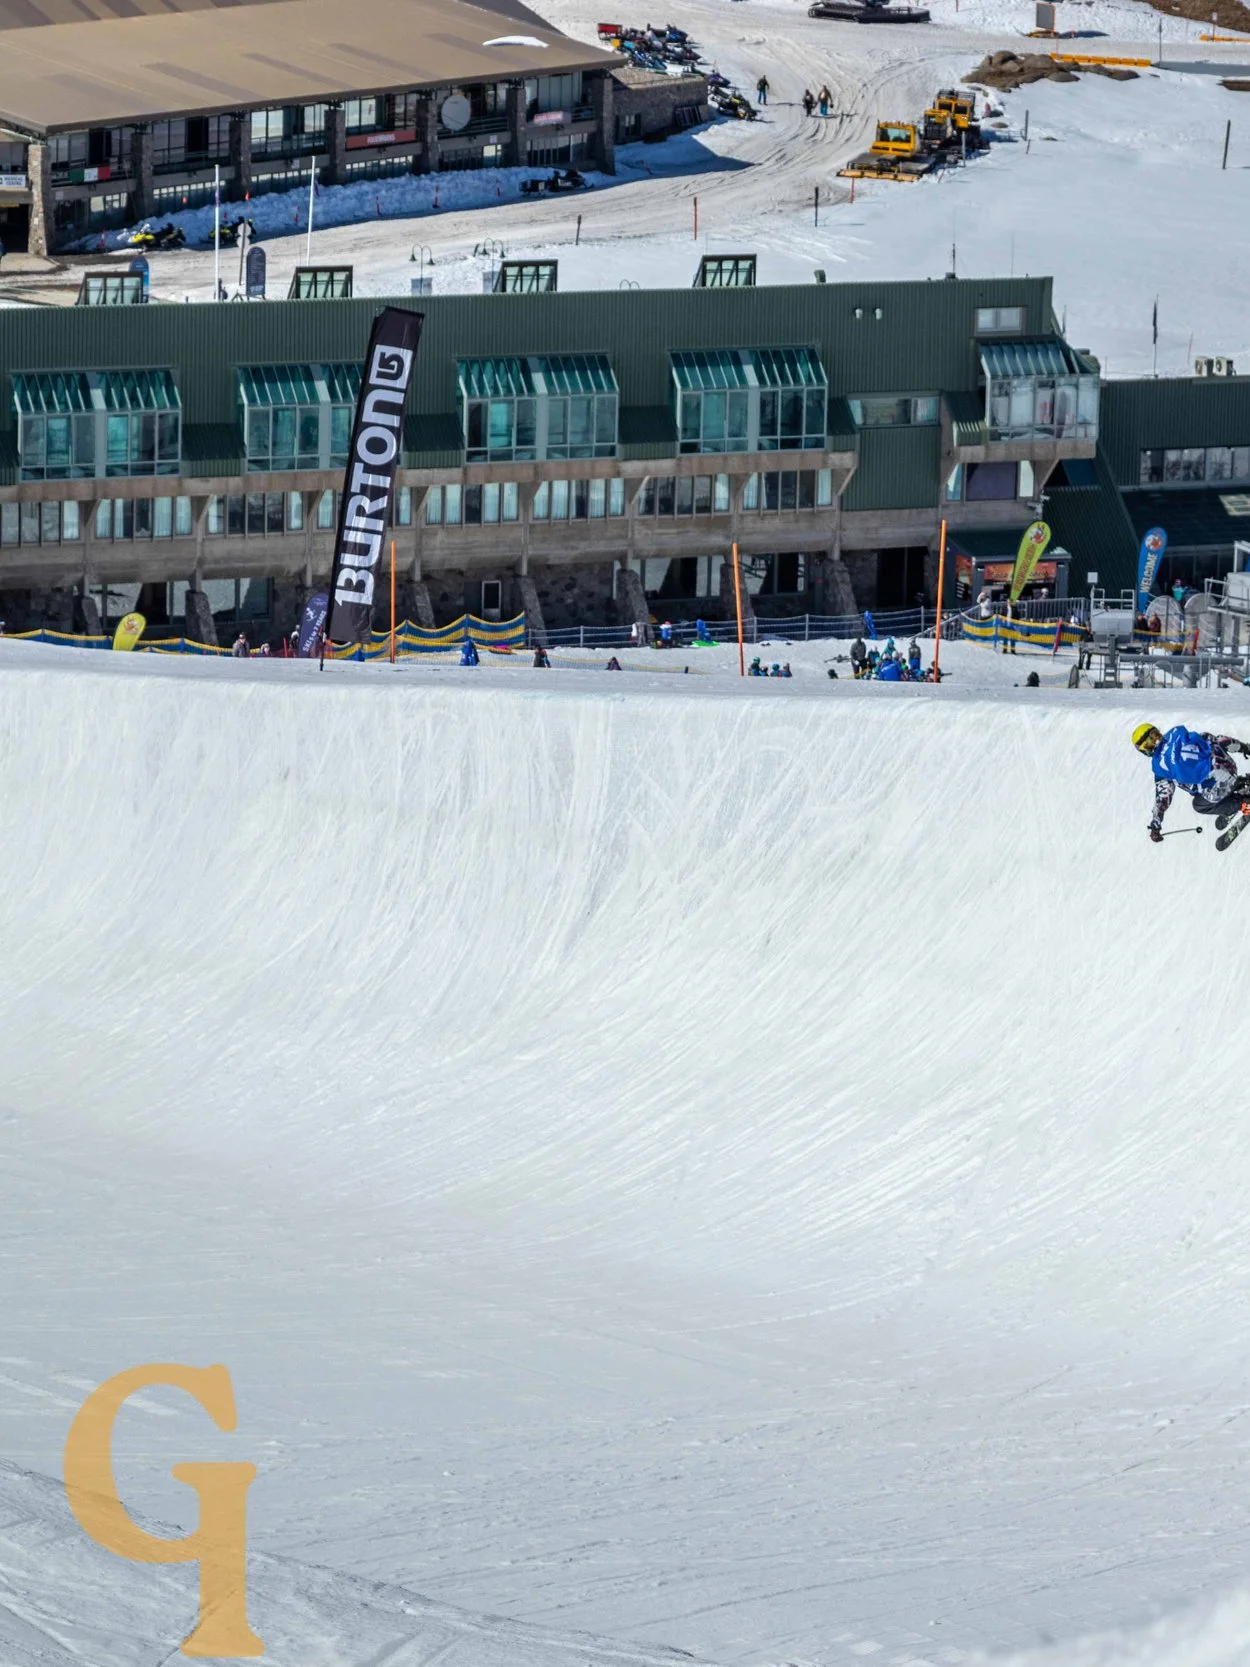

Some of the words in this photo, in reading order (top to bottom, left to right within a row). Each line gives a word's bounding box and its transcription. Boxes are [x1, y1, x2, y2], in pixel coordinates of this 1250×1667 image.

[335, 388, 405, 606] BURTON
[1140, 552, 1158, 593] WELCOME
[302, 639, 312, 652] SKI
